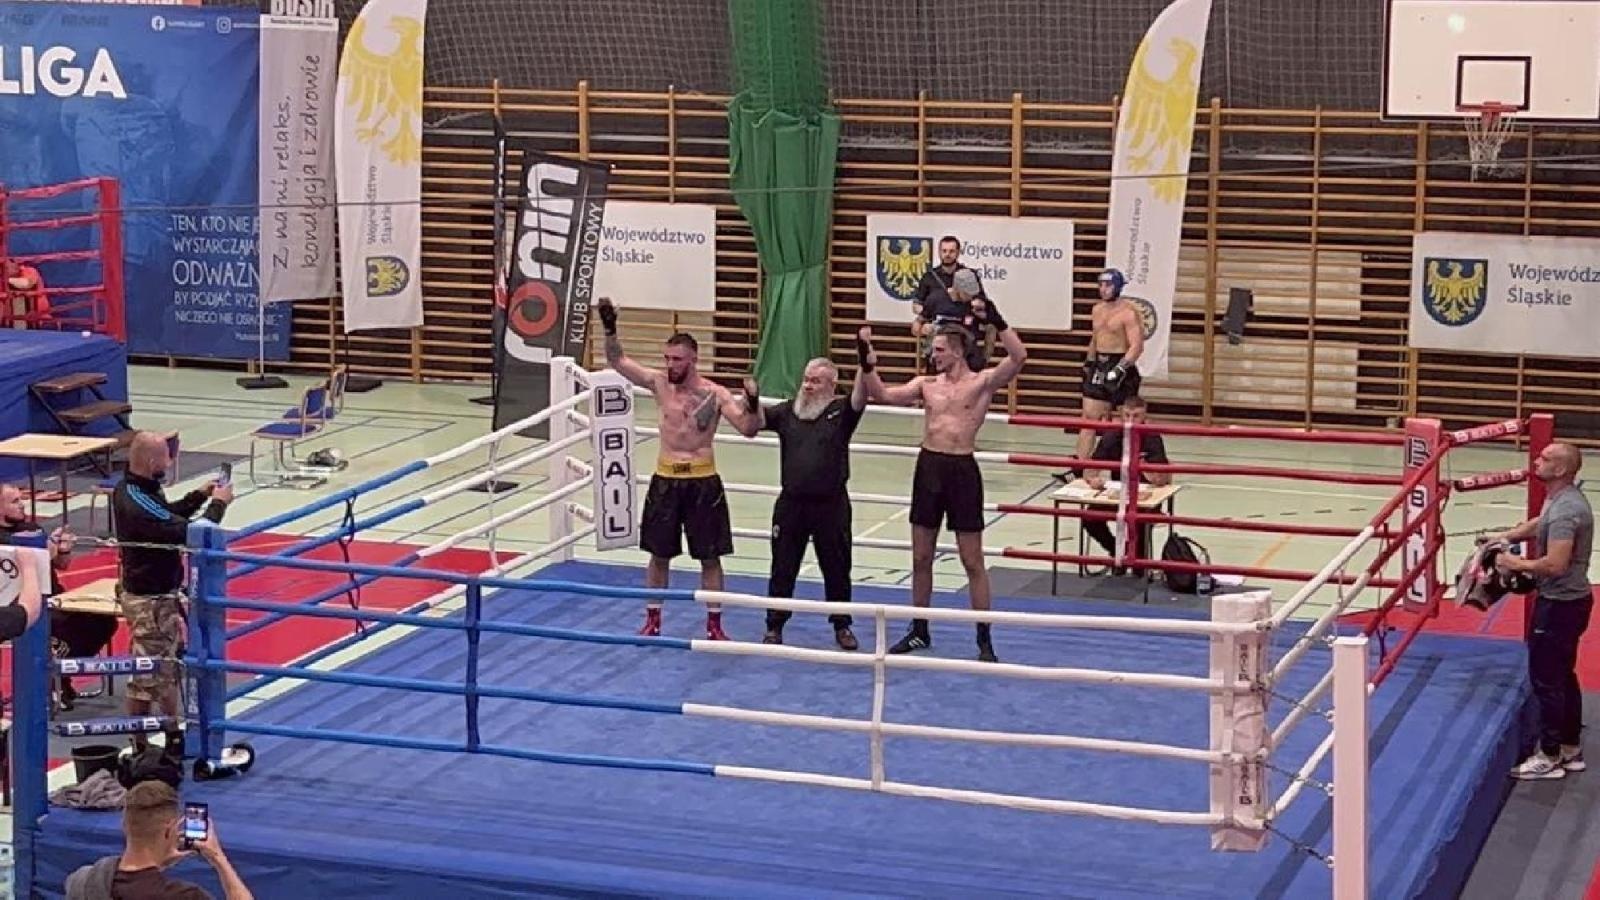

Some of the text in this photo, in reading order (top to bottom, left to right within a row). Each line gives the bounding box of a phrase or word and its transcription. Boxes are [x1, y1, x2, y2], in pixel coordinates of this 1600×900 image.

[0, 46, 127, 98] LIGA
[296, 55, 326, 268] kondycja i zdrowie
[272, 95, 290, 269] Z nami relaks,
[201, 215, 226, 232] KTO
[228, 215, 250, 232] NIE
[601, 225, 706, 245] Województwo
[575, 202, 602, 298] SPORTOWY
[601, 245, 654, 266] Śląskie
[172, 256, 260, 287] ODWAŻN
[976, 263, 1007, 280] skie
[1506, 284, 1572, 308] Śląskie
[570, 302, 588, 344] KLUB
[604, 432, 626, 533] BAIL
